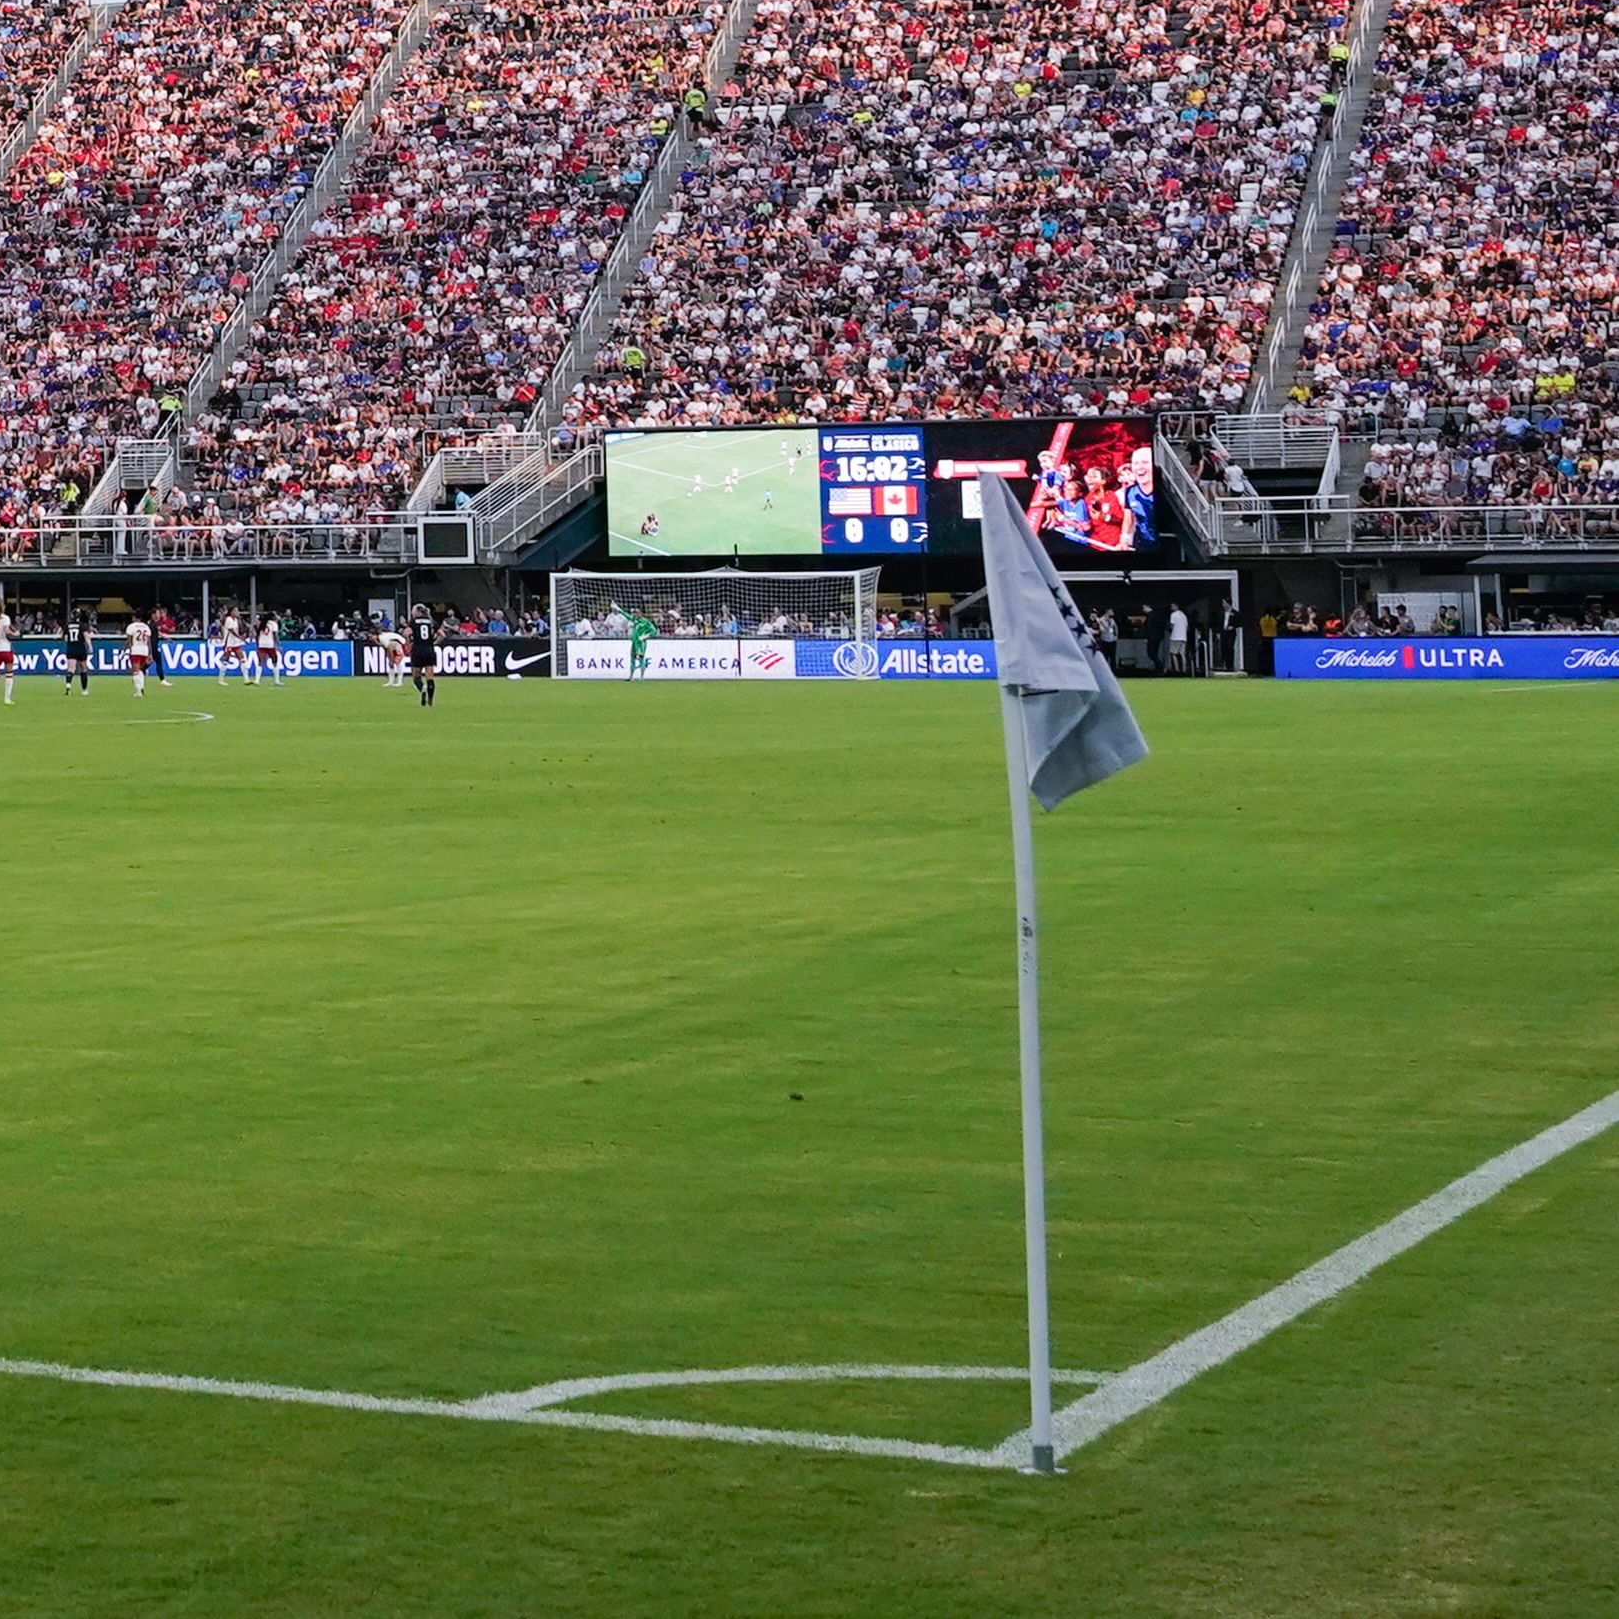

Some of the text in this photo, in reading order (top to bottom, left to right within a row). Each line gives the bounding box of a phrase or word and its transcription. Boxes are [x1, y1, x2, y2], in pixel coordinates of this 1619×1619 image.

[836, 455, 908, 482] 16:02
[844, 517, 909, 543] 0 0
[68, 628, 80, 642] 17
[420, 624, 430, 640] 8
[41, 648, 94, 670] Yok
[98, 648, 134, 670] Lif
[363, 645, 496, 674] NIE OCCER
[576, 657, 625, 669] BANK
[658, 657, 740, 669] AMERICA
[880, 648, 985, 673] Allstate
[1315, 648, 1504, 668] Michelob ULTRA
